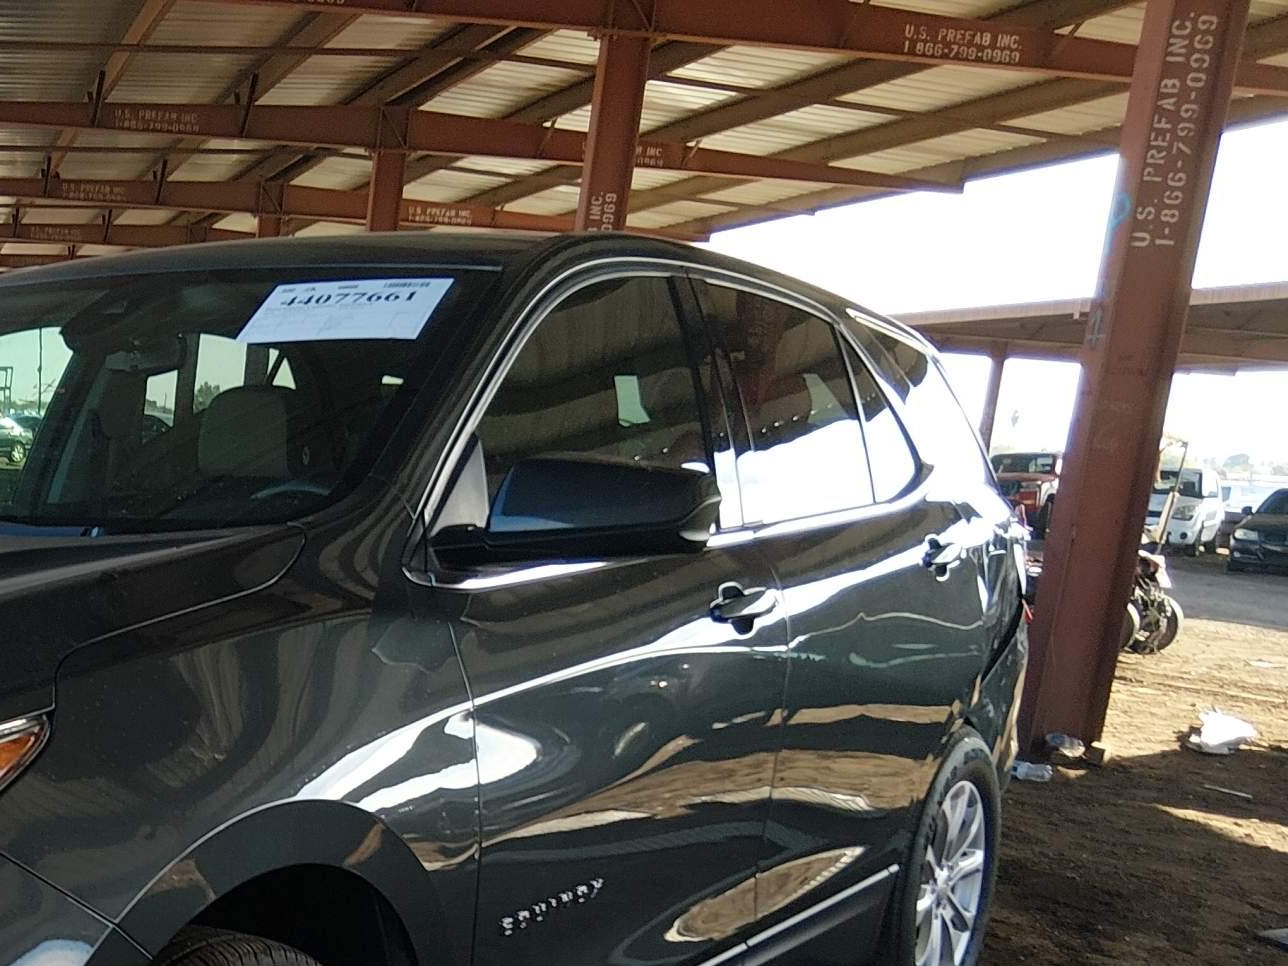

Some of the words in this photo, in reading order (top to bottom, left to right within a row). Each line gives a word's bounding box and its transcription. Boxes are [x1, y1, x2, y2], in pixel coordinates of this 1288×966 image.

[904, 23, 931, 40] U.S.
[937, 28, 991, 46] PREFAB
[996, 33, 1023, 50] INC.
[1166, 11, 1196, 63] INC.
[1143, 77, 1181, 182] PREFAB
[1154, 14, 1219, 247] 1-866-799-0969
[1131, 198, 1159, 248] U.S.
[280, 290, 418, 306] 44077661
